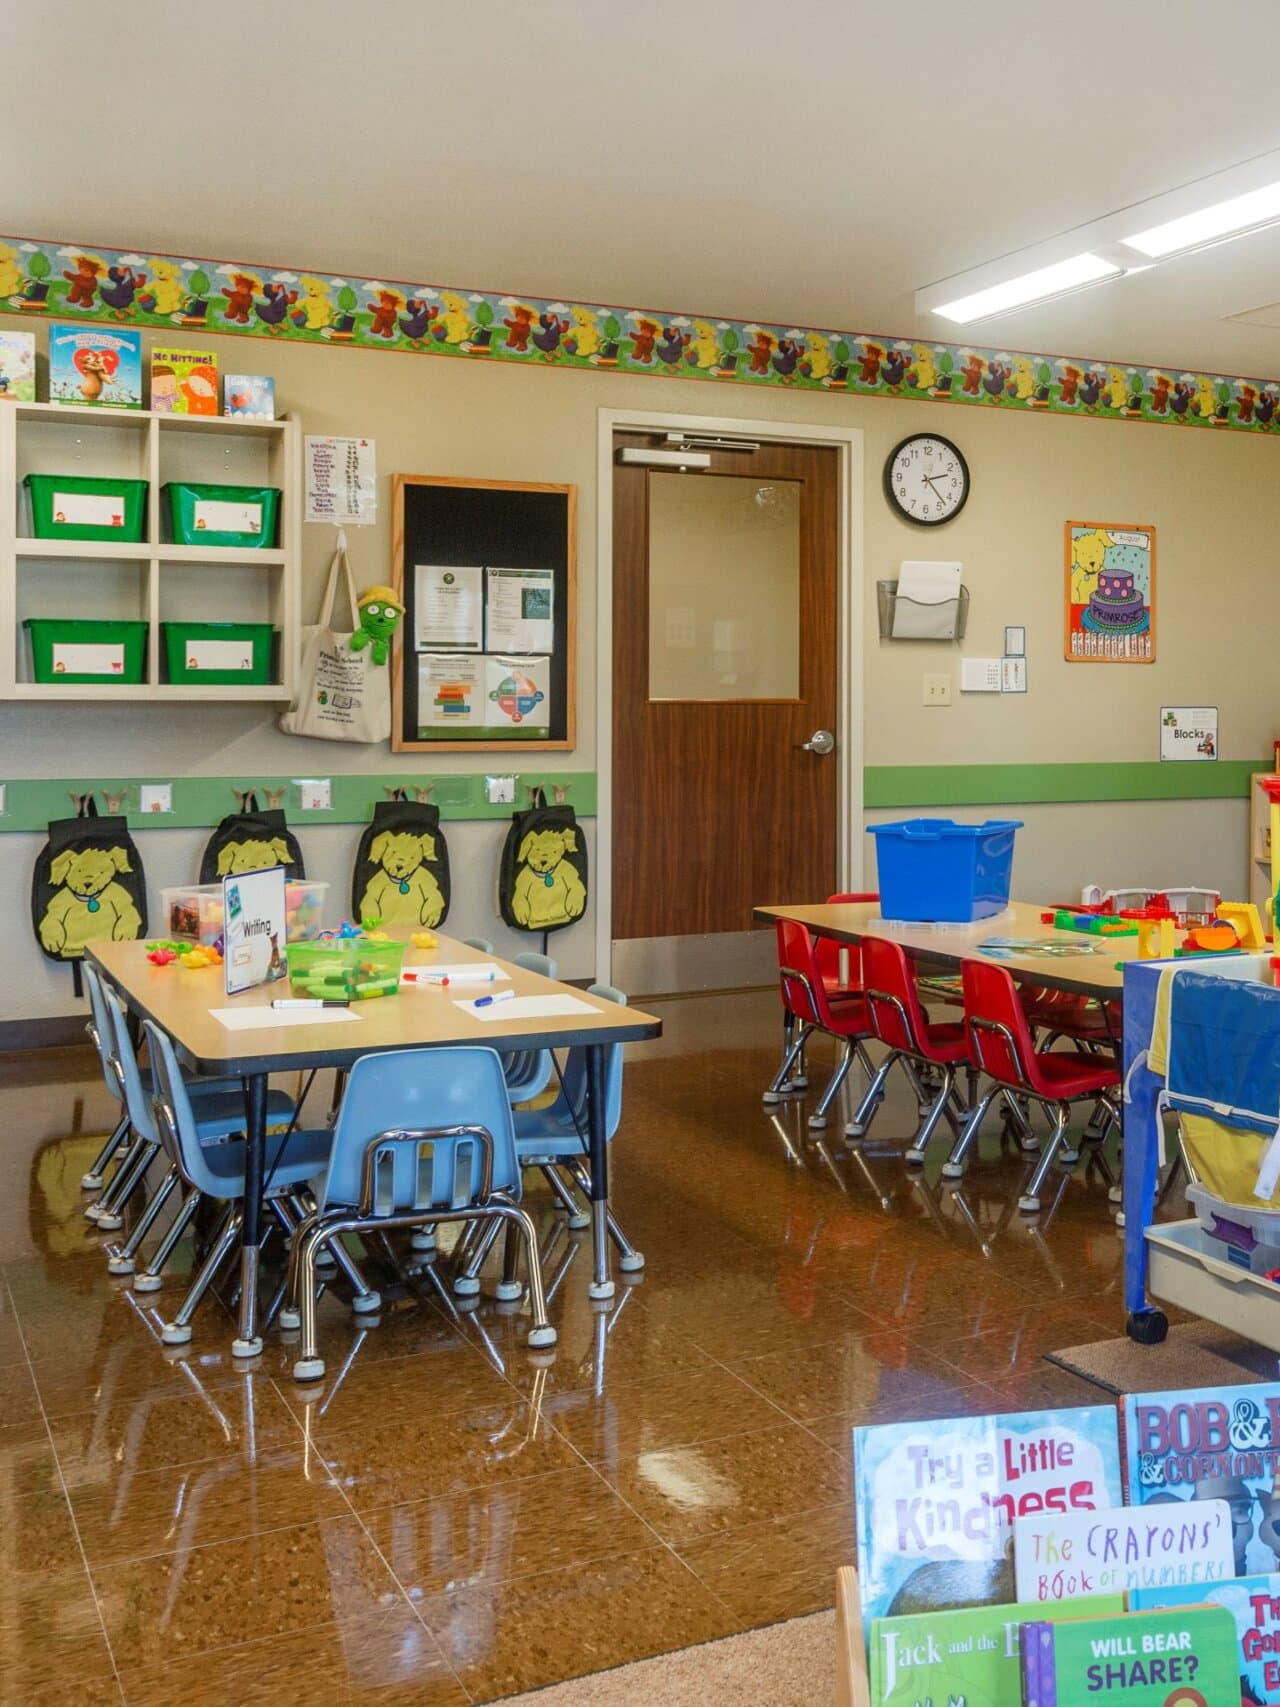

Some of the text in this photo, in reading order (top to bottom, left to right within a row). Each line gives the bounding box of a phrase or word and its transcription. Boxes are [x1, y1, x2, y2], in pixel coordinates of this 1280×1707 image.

[170, 353, 213, 365] HITTING!
[910, 449, 918, 458] 11
[924, 446, 933, 456] 12
[901, 458, 910, 468] 10
[947, 462, 954, 472] 2
[896, 472, 902, 482] 9
[952, 478, 958, 488] 3
[900, 488, 906, 497] 8
[946, 492, 952, 501] 4
[910, 500, 916, 508] 7
[922, 504, 928, 514] 6
[936, 501, 942, 511] 5
[1093, 604, 1138, 622] PRIMROSE
[1174, 729, 1204, 739] Blocks
[243, 918, 272, 938] Writing
[1137, 1402, 1230, 1457] BOB
[1229, 1398, 1272, 1450] &
[907, 1444, 964, 1489] Try
[976, 1451, 994, 1478] a
[1003, 1437, 1075, 1482] Little
[1139, 1452, 1165, 1485] &
[1164, 1452, 1231, 1484] CORN
[1232, 1450, 1263, 1478] ON
[895, 1480, 1096, 1551] Kindness
[1032, 1513, 1221, 1565] The CRAYONS'
[1090, 1631, 1192, 1659] WILL BEAR
[880, 1631, 943, 1703] Jack
[948, 1636, 973, 1654] and
[977, 1633, 998, 1651] the
[1086, 1655, 1200, 1692] SHARE?
